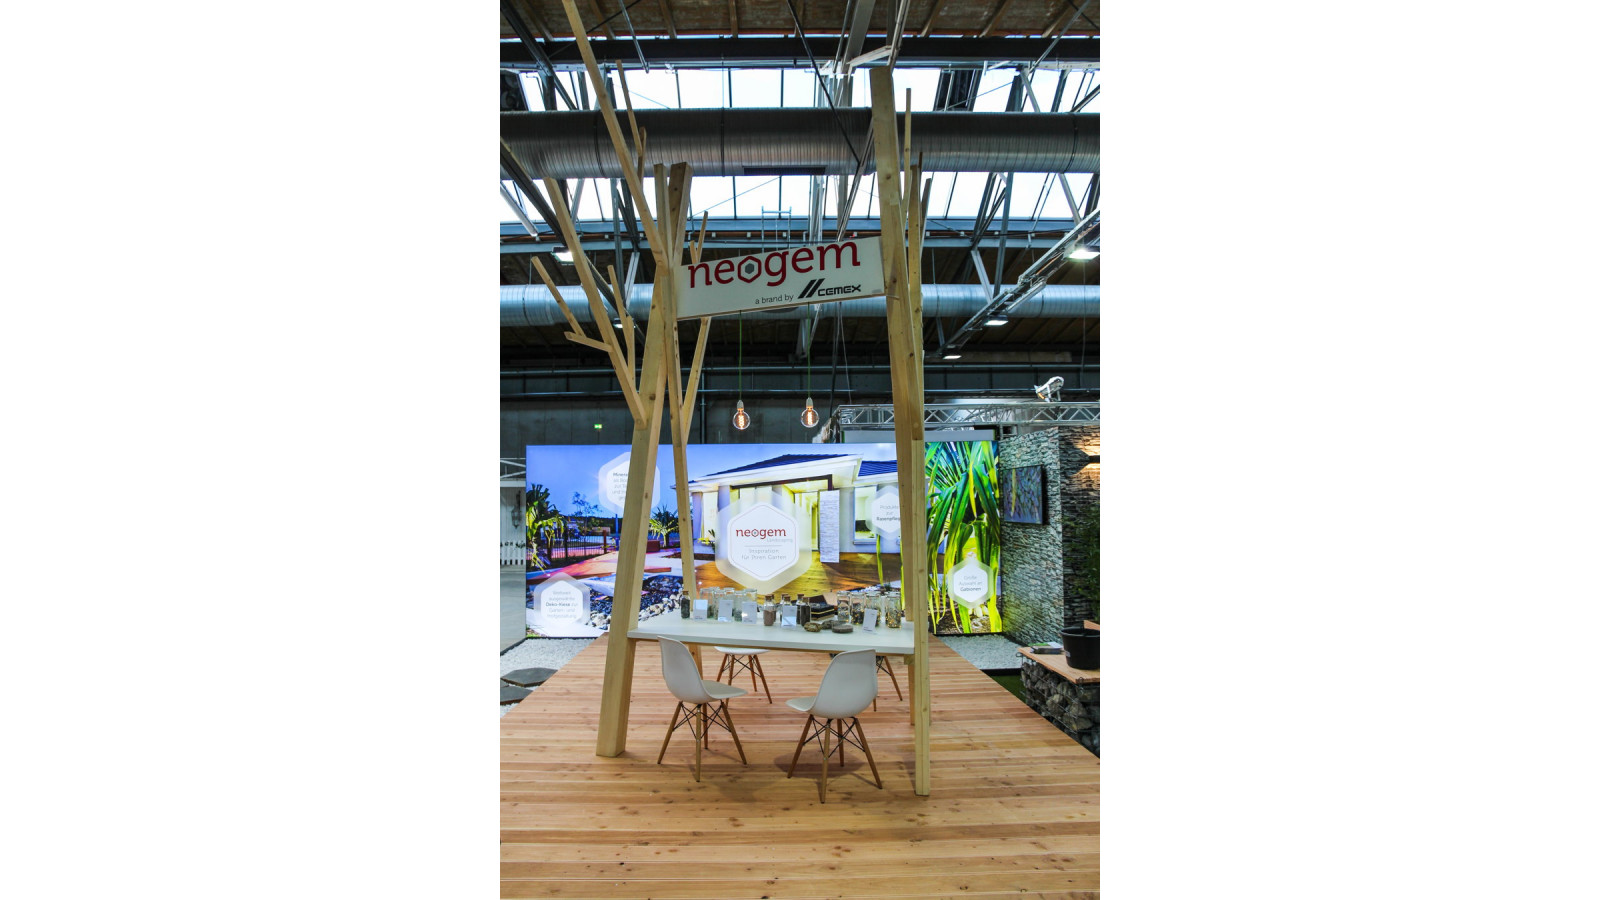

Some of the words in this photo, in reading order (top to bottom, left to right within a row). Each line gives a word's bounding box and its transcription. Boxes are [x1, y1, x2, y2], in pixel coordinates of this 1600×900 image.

[688, 241, 860, 288] neogem
[761, 294, 783, 304] brand
[784, 293, 794, 302] by
[735, 528, 787, 540] neogem
